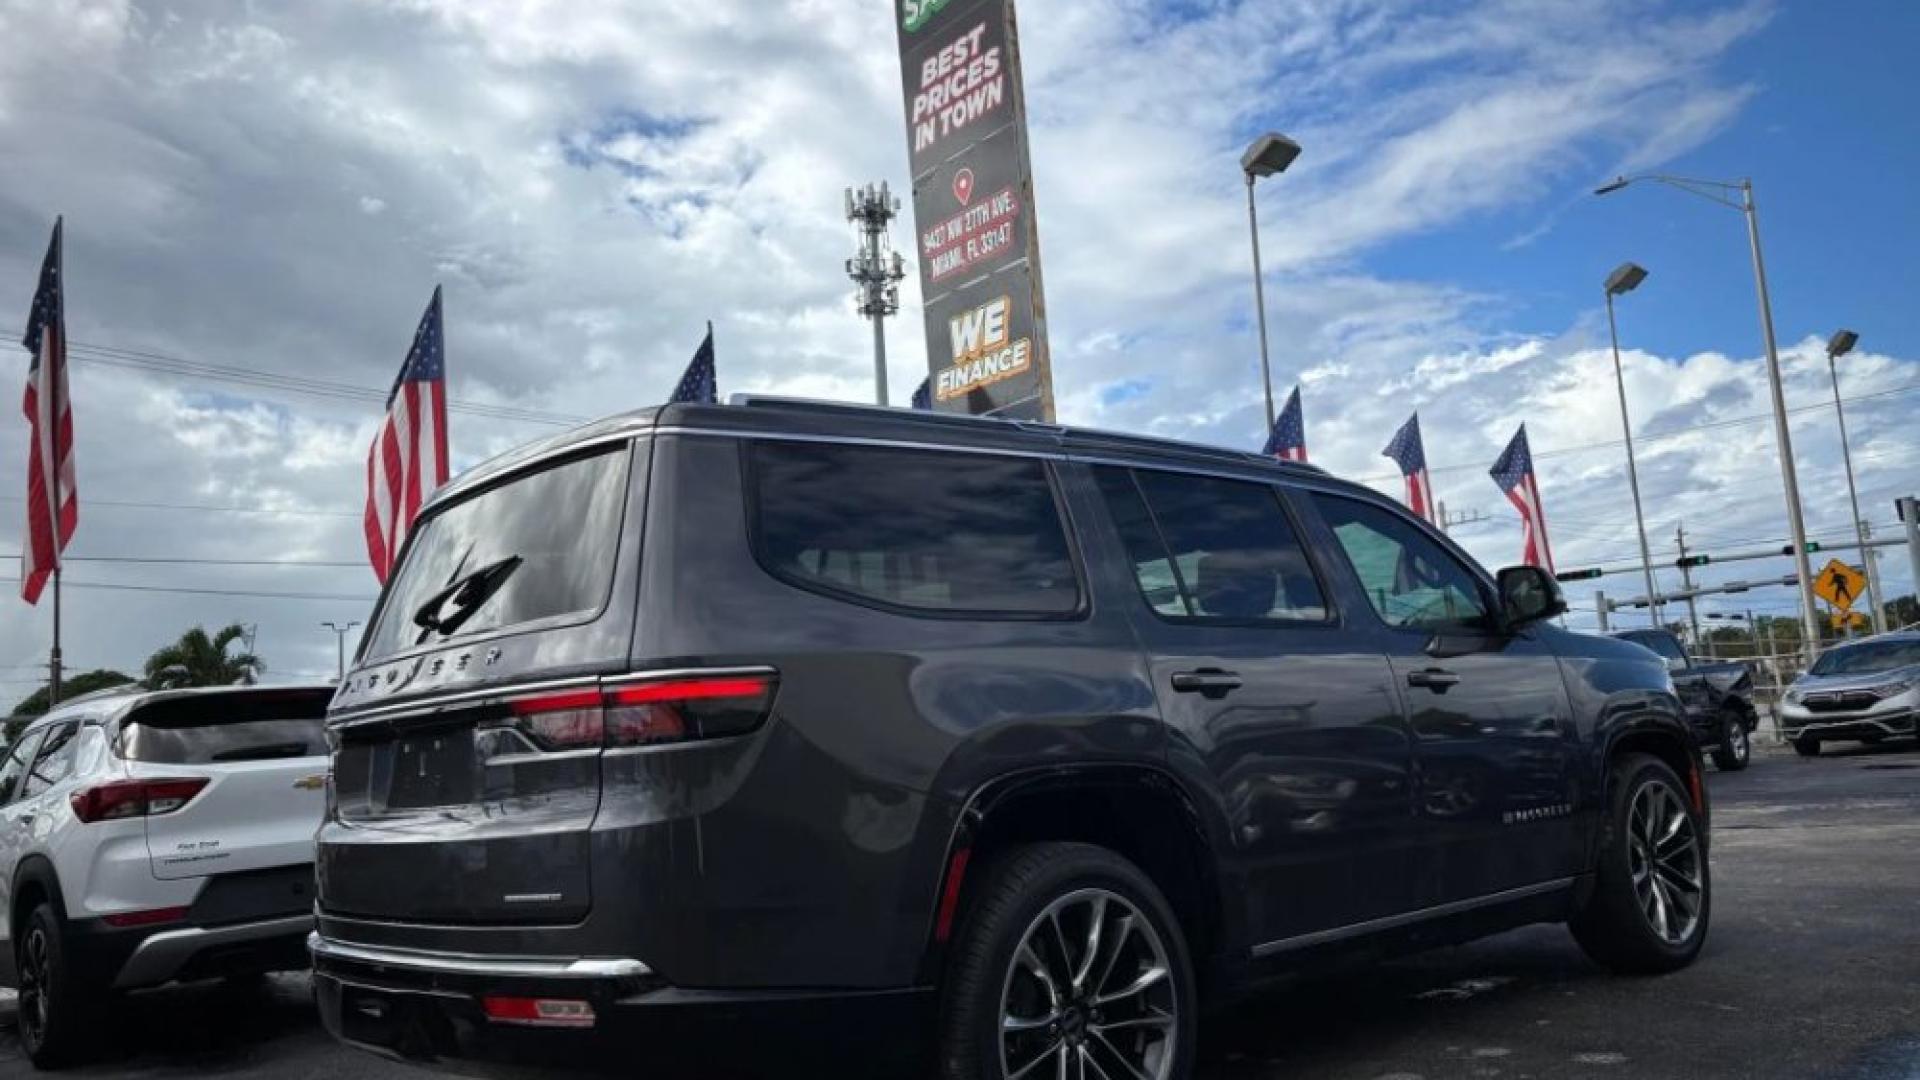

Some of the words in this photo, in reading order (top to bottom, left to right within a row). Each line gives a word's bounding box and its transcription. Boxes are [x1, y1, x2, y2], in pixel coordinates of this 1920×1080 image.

[913, 47, 999, 124] PRICES
[922, 22, 986, 88] BEST
[915, 116, 936, 152] IN
[940, 72, 1003, 136] TOWN
[965, 202, 990, 231] 27TH
[951, 298, 1007, 361] WE
[937, 338, 1029, 399] FINANCE
